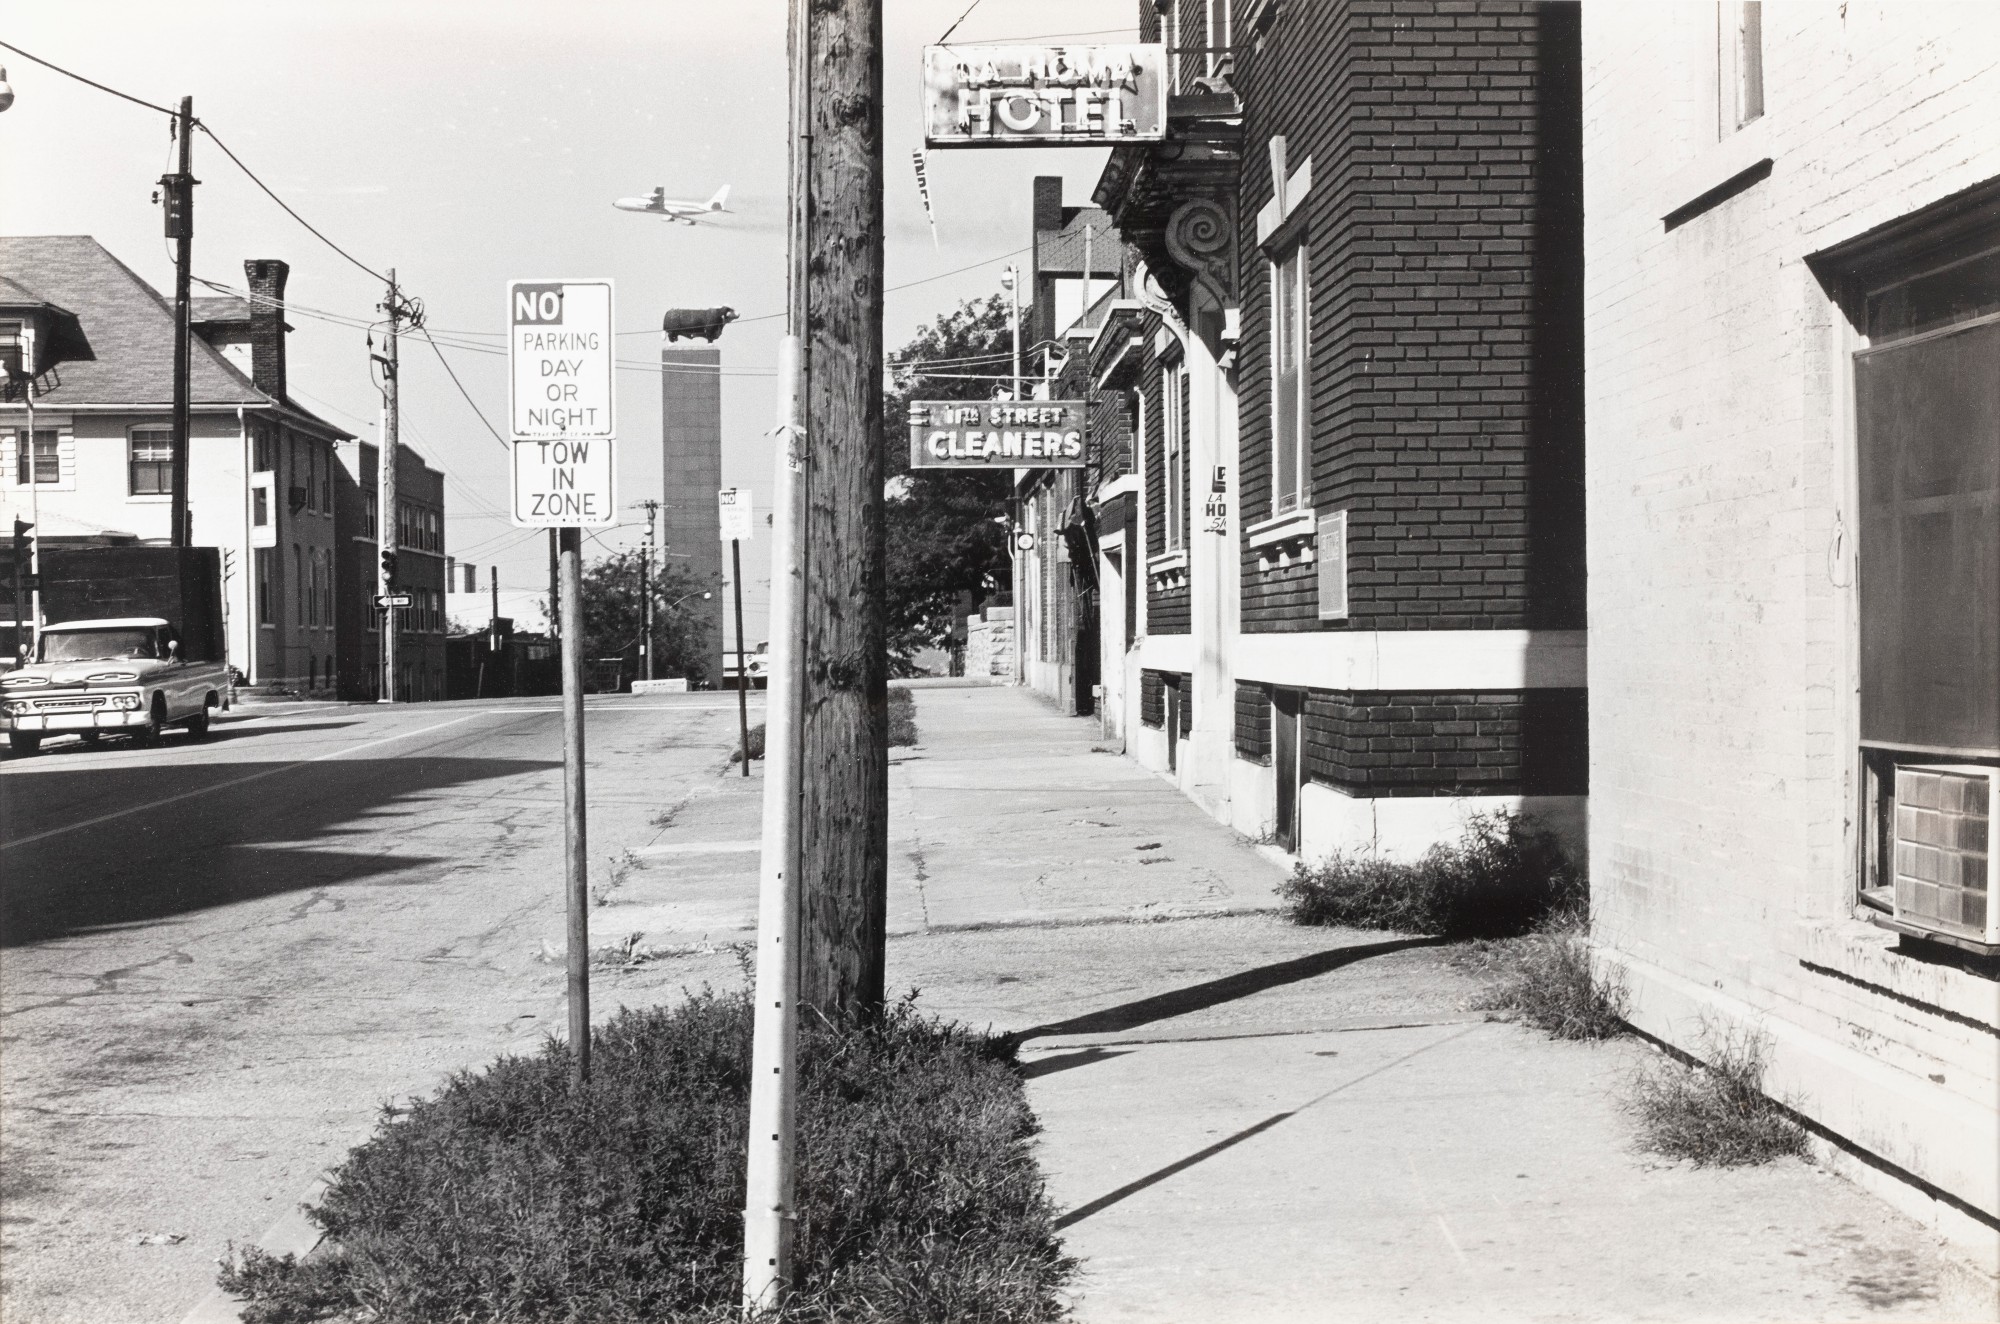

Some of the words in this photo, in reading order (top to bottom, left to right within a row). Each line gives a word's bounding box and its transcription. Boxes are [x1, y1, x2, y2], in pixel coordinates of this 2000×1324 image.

[958, 88, 1136, 132] HOTEL
[515, 291, 560, 321] NO
[523, 332, 599, 351] PARKING
[541, 359, 584, 377] DAY
[546, 383, 578, 402] OR
[528, 407, 598, 427] NIGHT
[990, 406, 1063, 425] STREET
[537, 441, 589, 465] TOW
[928, 430, 1082, 458] CLEANERS
[552, 467, 574, 490] IN
[531, 493, 596, 516] ZONE
[721, 494, 735, 504] NO
[1208, 494, 1222, 503] LA
